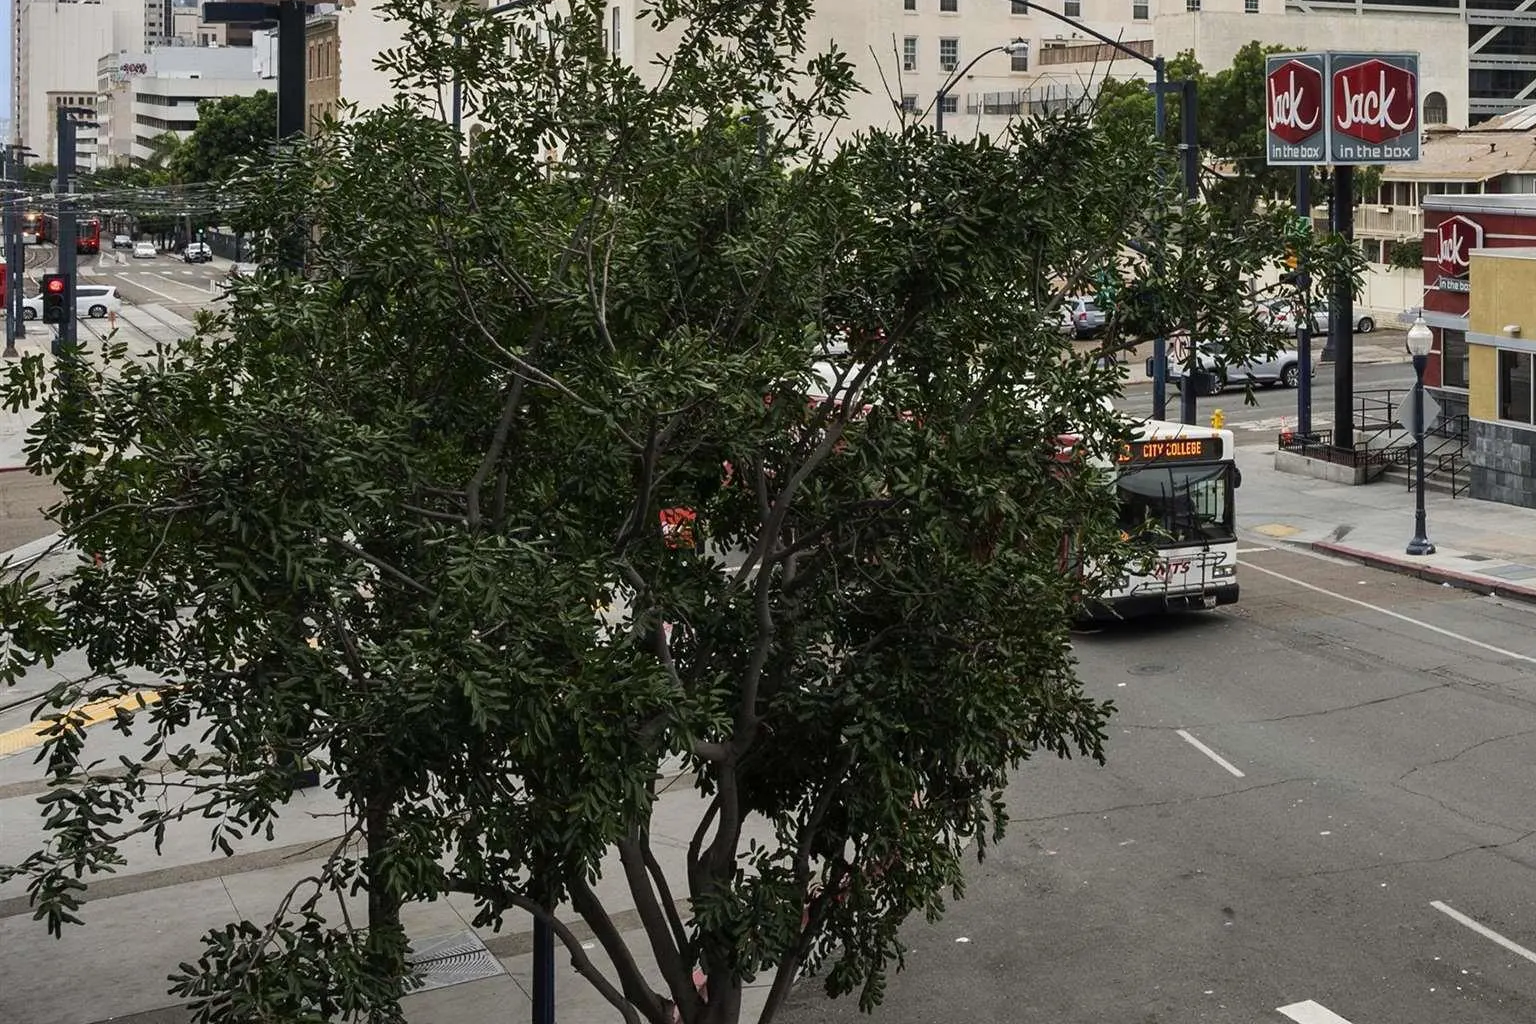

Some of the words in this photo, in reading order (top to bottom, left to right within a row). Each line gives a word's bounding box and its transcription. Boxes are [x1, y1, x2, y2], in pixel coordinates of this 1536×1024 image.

[1269, 70, 1320, 130] Jack
[1337, 70, 1414, 130] Jack
[1272, 144, 1282, 158] in
[1283, 144, 1299, 158] the
[1300, 144, 1320, 158] box
[1340, 144, 1354, 158] in
[1356, 144, 1381, 158] the
[1383, 144, 1412, 158] box
[1437, 223, 1470, 266] Jack
[1440, 278, 1447, 288] in
[1447, 280, 1459, 290] the
[1143, 443, 1164, 458] CITY
[1166, 441, 1202, 456] COLLEGE
